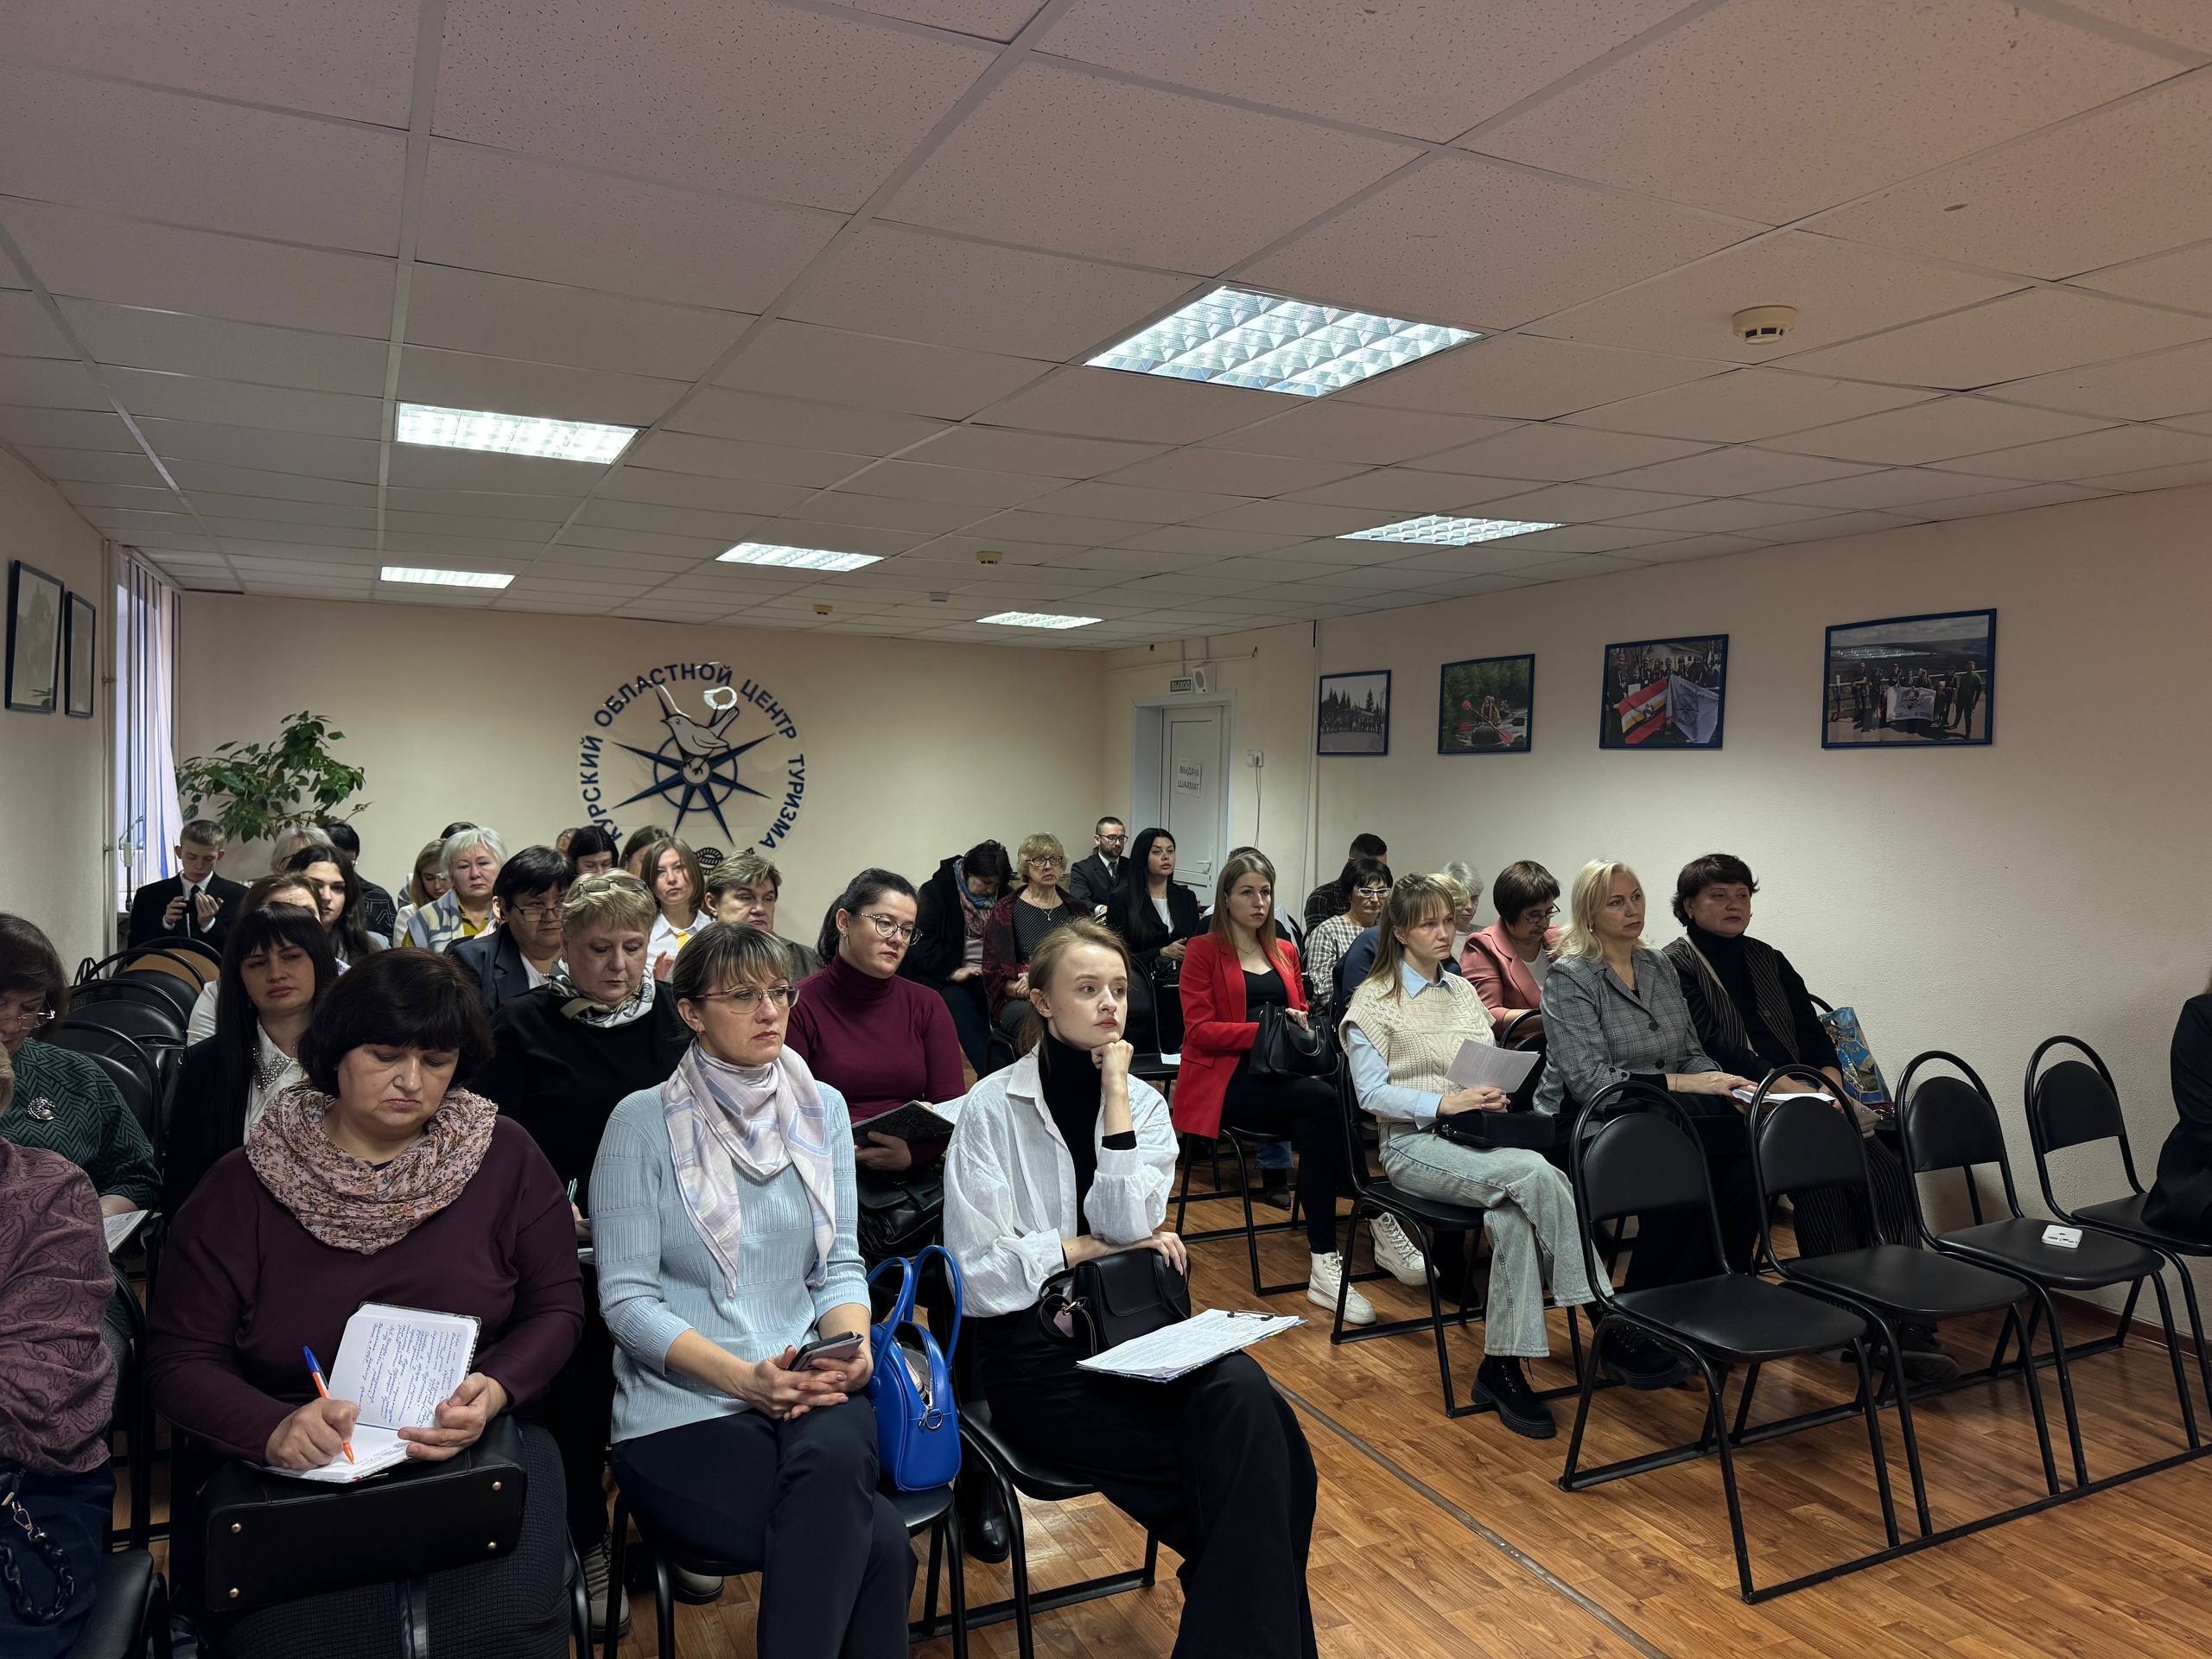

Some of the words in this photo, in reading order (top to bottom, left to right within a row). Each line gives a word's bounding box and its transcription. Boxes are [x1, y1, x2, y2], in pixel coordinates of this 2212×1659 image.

[594, 663, 734, 728] ОБЛАСТНОЙ
[1172, 681, 1190, 691] ВЫХОД
[740, 679, 797, 740] ЦЕНТР
[1178, 780, 1199, 791] ШАХМАТ
[1179, 766, 1199, 777] ВЫДАЧА
[759, 754, 805, 849] ТУРИЗМА
